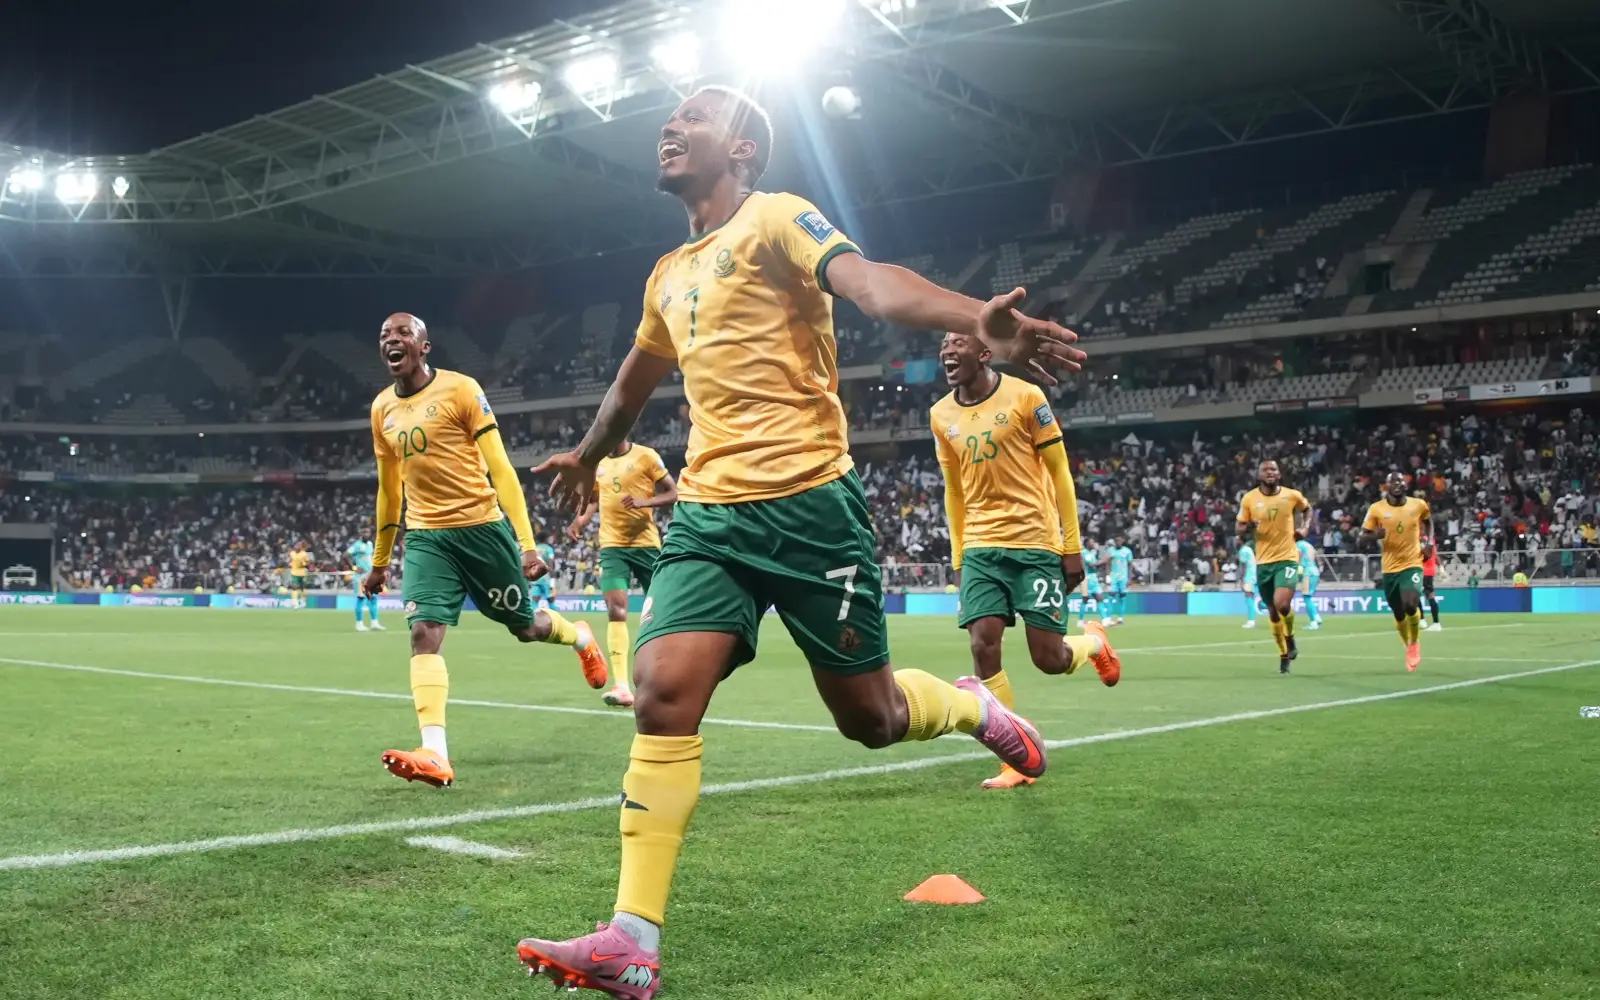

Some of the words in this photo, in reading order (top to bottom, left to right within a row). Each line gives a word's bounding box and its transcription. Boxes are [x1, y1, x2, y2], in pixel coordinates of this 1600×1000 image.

[684, 286, 699, 347] 7
[397, 426, 427, 458] 20
[966, 430, 998, 464] 23
[612, 476, 622, 494] 5
[1268, 508, 1279, 522] 17
[1396, 520, 1404, 534] 6
[1285, 566, 1296, 579] 17
[1411, 572, 1420, 584] 6
[488, 584, 522, 611] 20
[825, 564, 858, 620] 7
[1033, 578, 1063, 608] 23
[1290, 596, 1372, 612] FINITY
